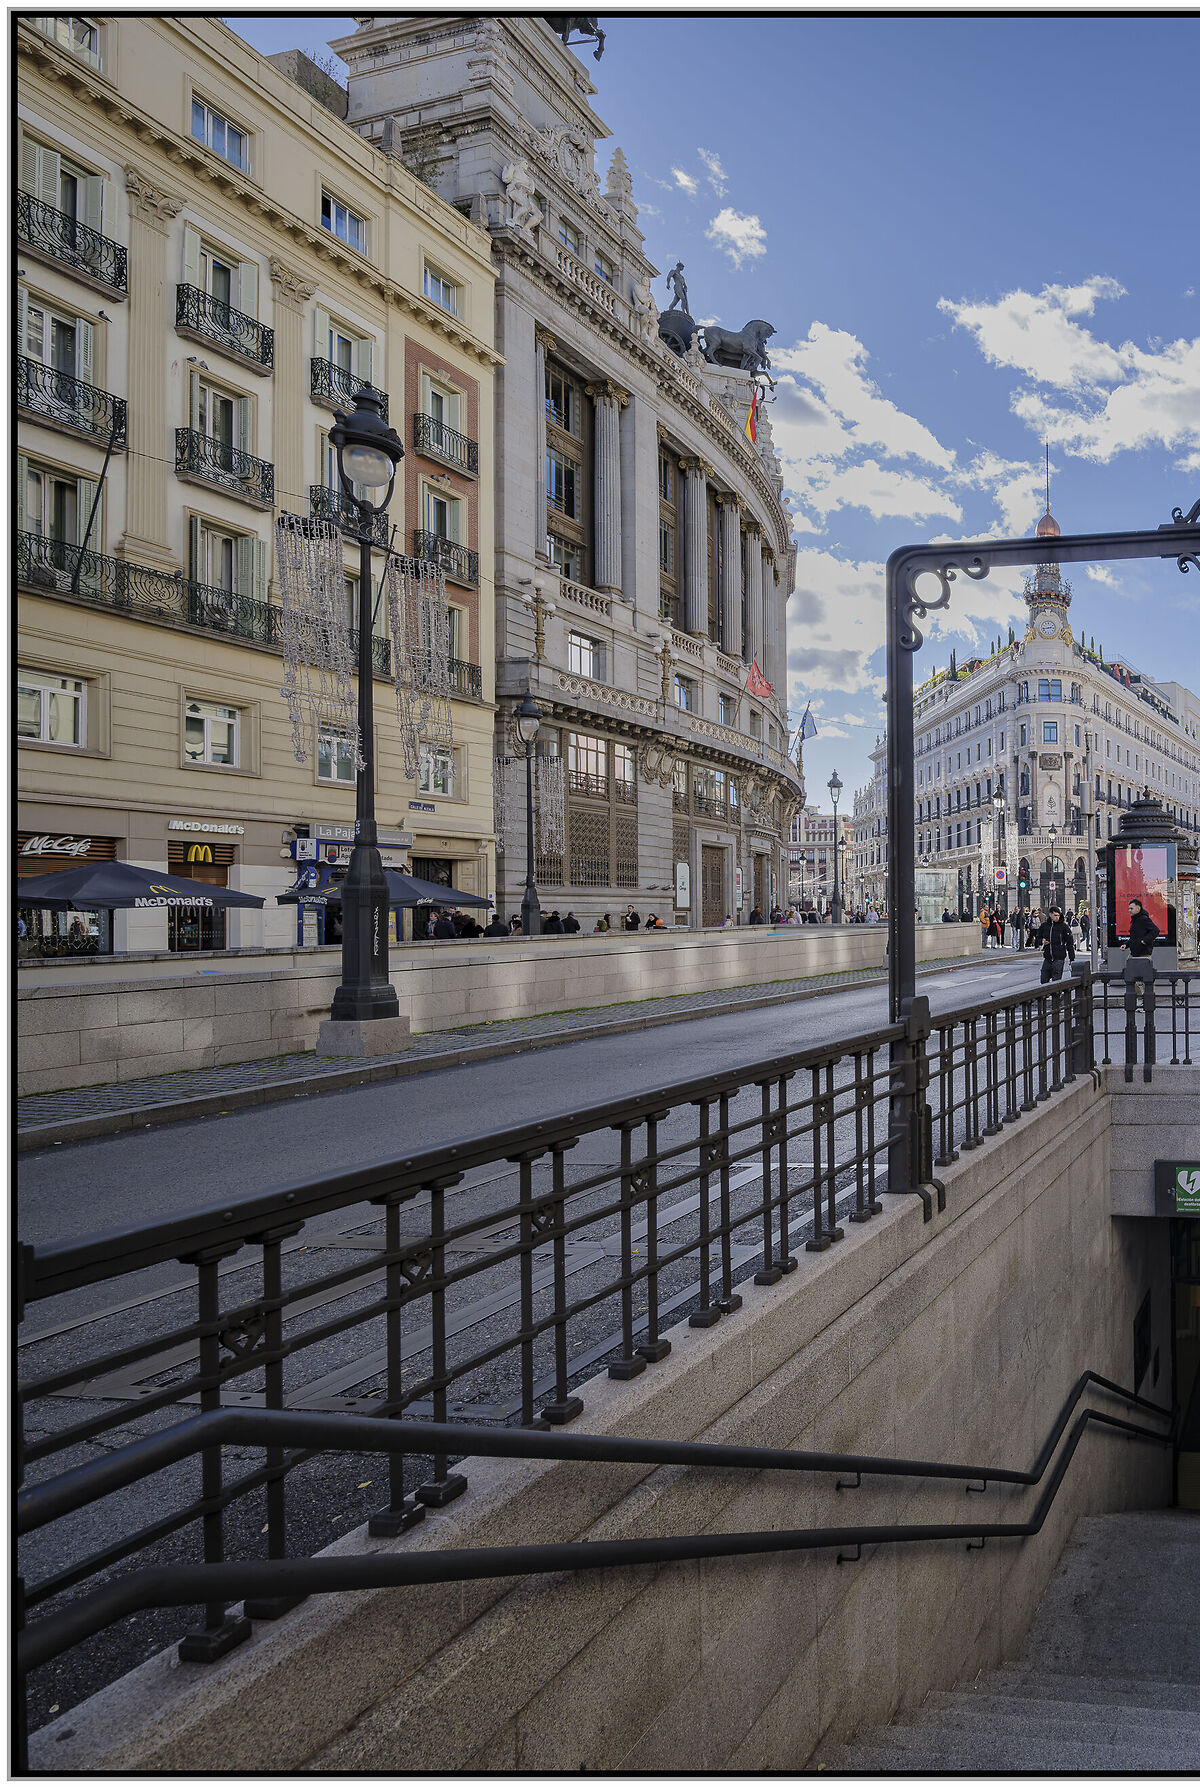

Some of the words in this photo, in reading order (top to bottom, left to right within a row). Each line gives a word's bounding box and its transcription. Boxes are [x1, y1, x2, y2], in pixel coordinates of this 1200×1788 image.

[168, 820, 245, 835] McDonald's
[319, 826, 332, 836] La
[134, 896, 214, 908] McDonald's
